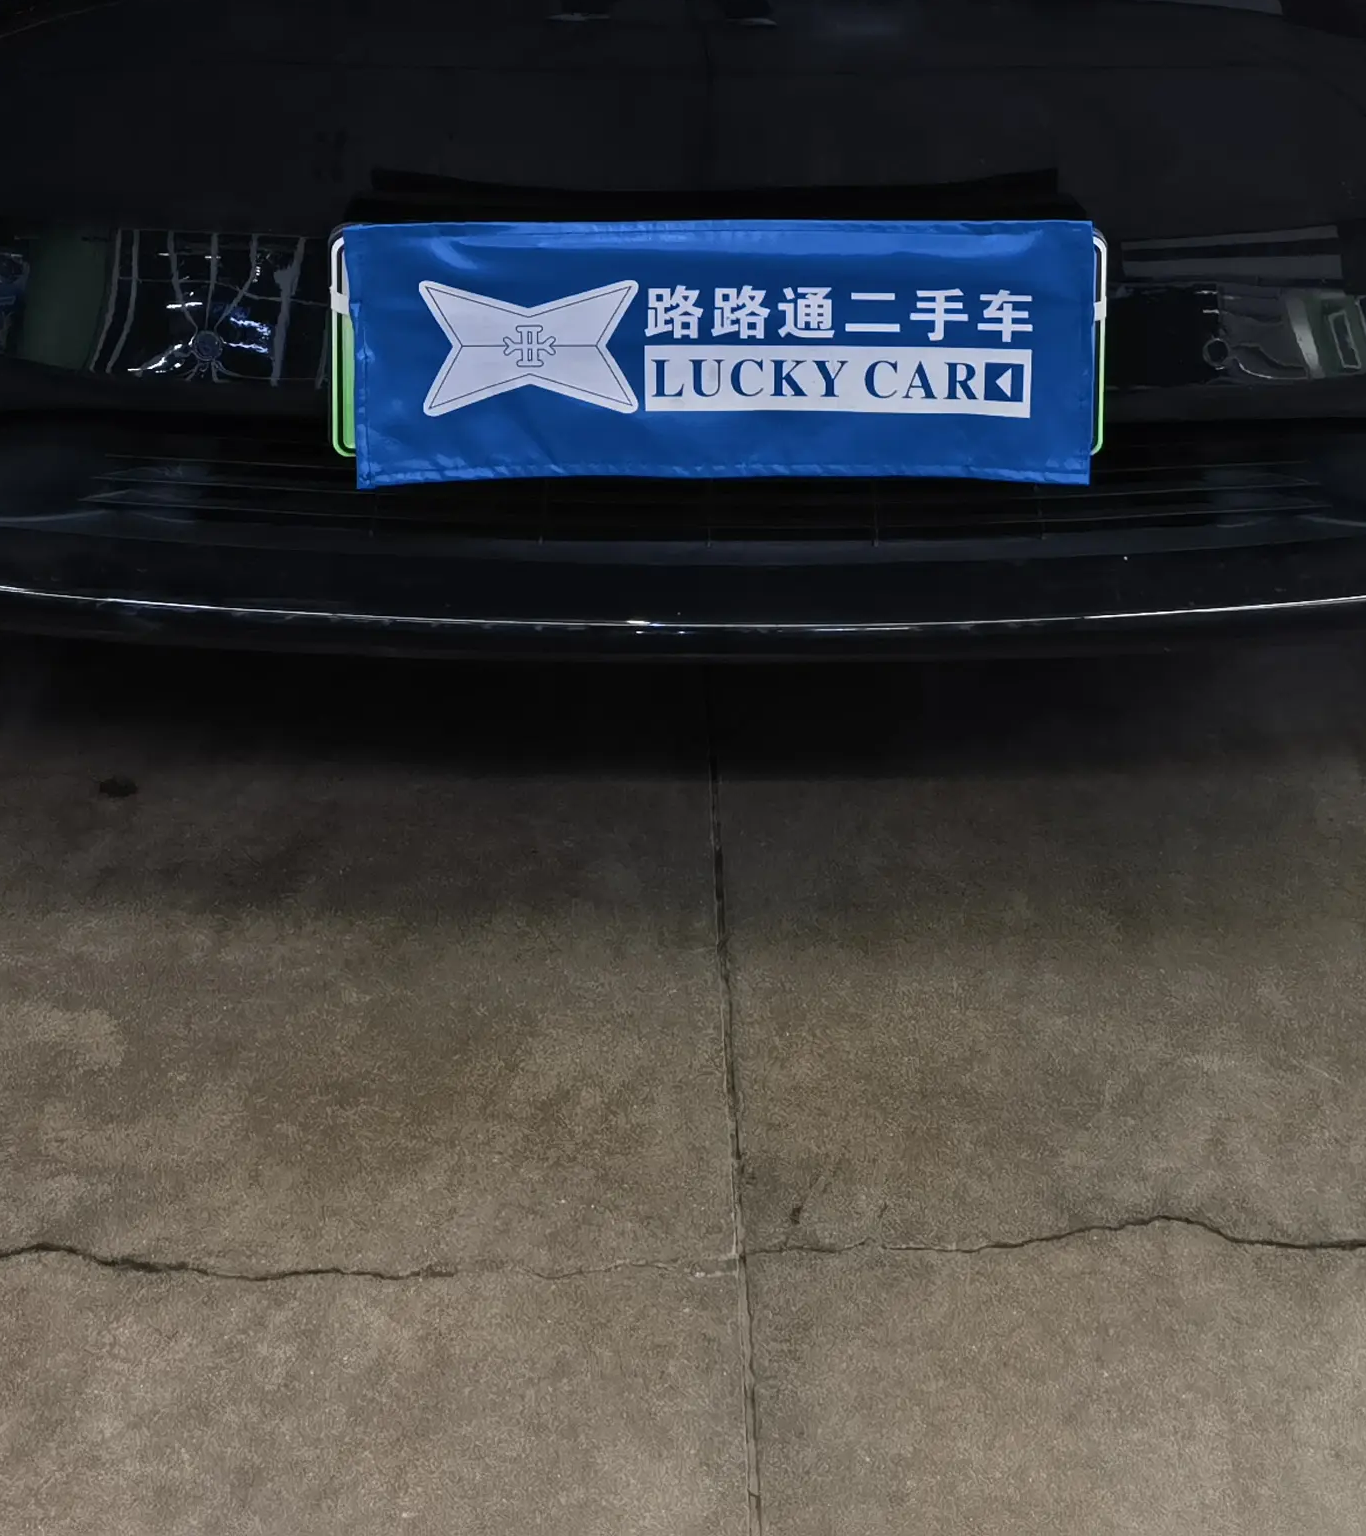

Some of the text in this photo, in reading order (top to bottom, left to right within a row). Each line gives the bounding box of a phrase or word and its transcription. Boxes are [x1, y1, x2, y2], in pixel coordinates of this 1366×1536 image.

[644, 284, 1033, 343] 路路通二手车
[651, 358, 979, 401] LUCKY CAR
